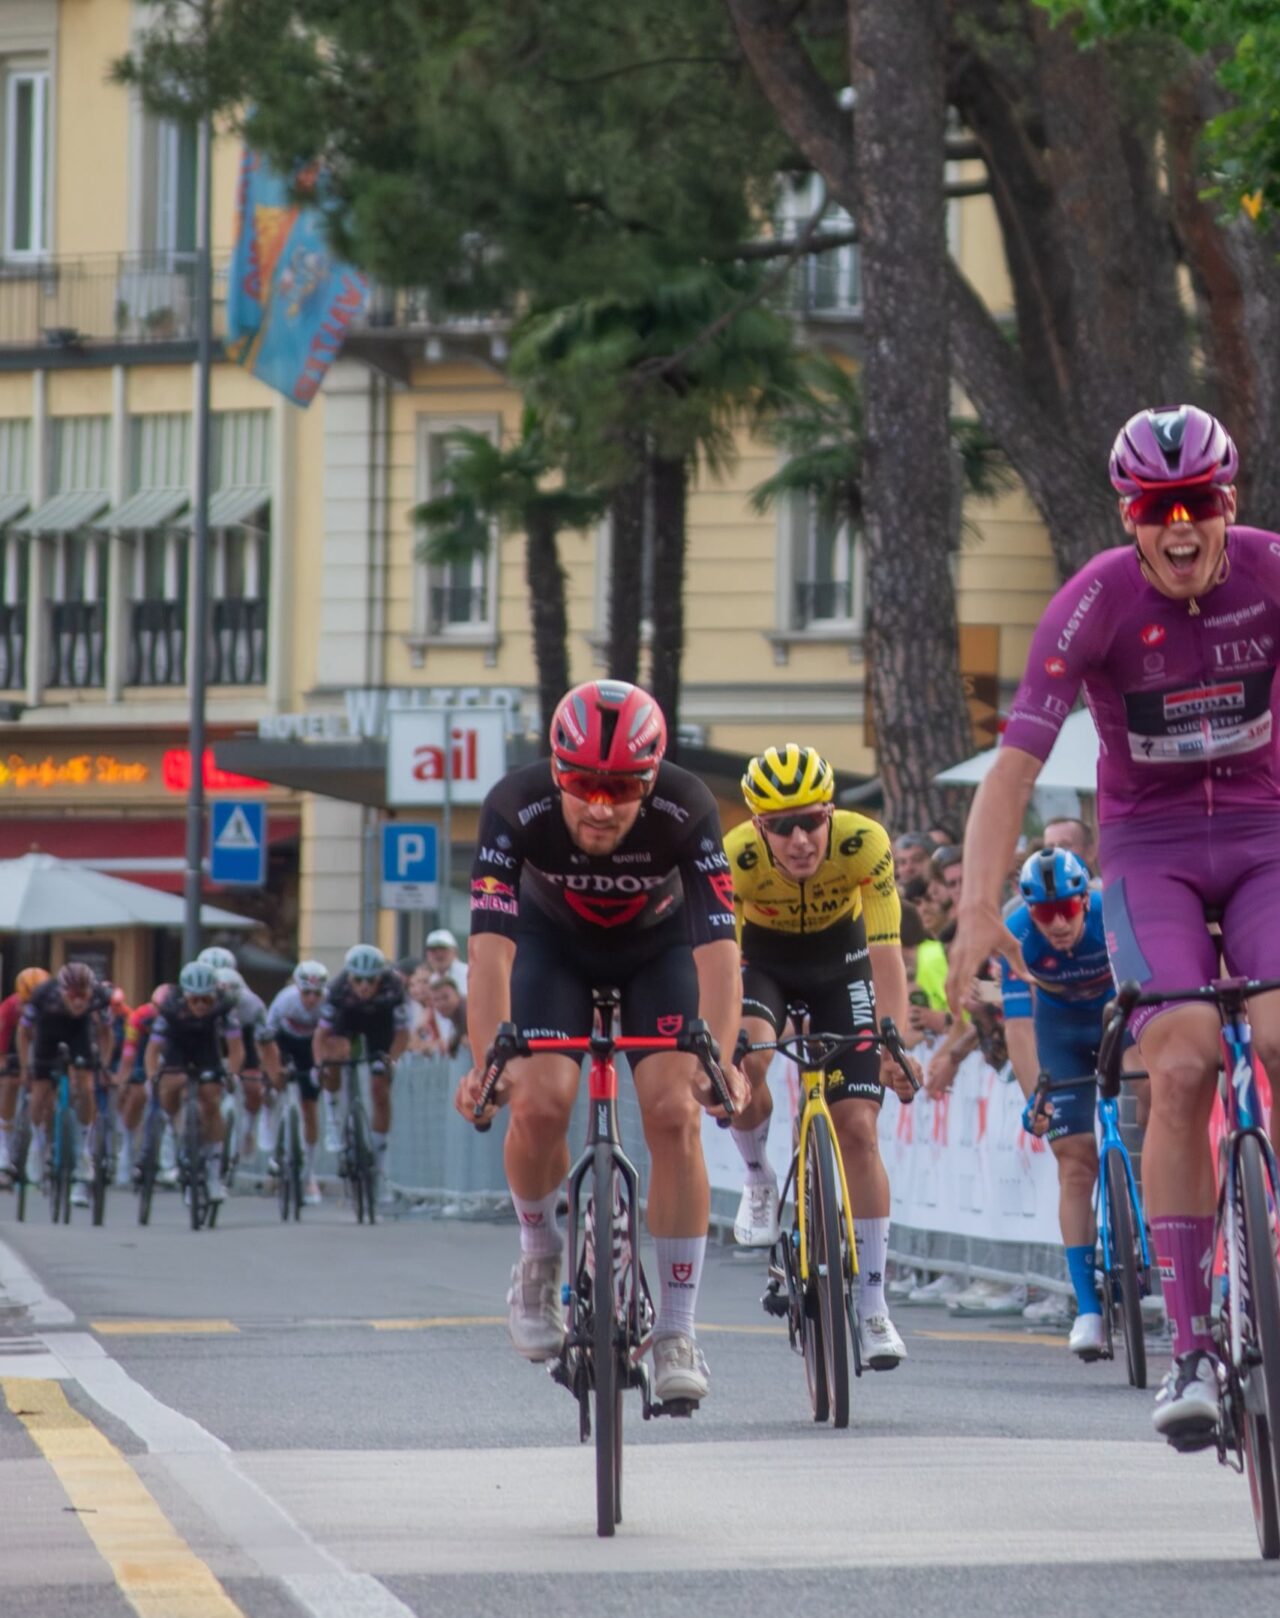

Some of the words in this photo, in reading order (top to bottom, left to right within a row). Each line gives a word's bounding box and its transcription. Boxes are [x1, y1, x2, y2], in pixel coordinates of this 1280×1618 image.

[1057, 578, 1103, 652] CASTELLI
[1213, 638, 1267, 667] ITA
[412, 728, 477, 782] ail
[518, 797, 552, 826] BMC
[652, 796, 689, 824] BMC
[397, 833, 426, 877] P
[479, 846, 517, 870] MSC
[846, 979, 874, 1027] VISMA
[597, 1103, 609, 1137] BMC
